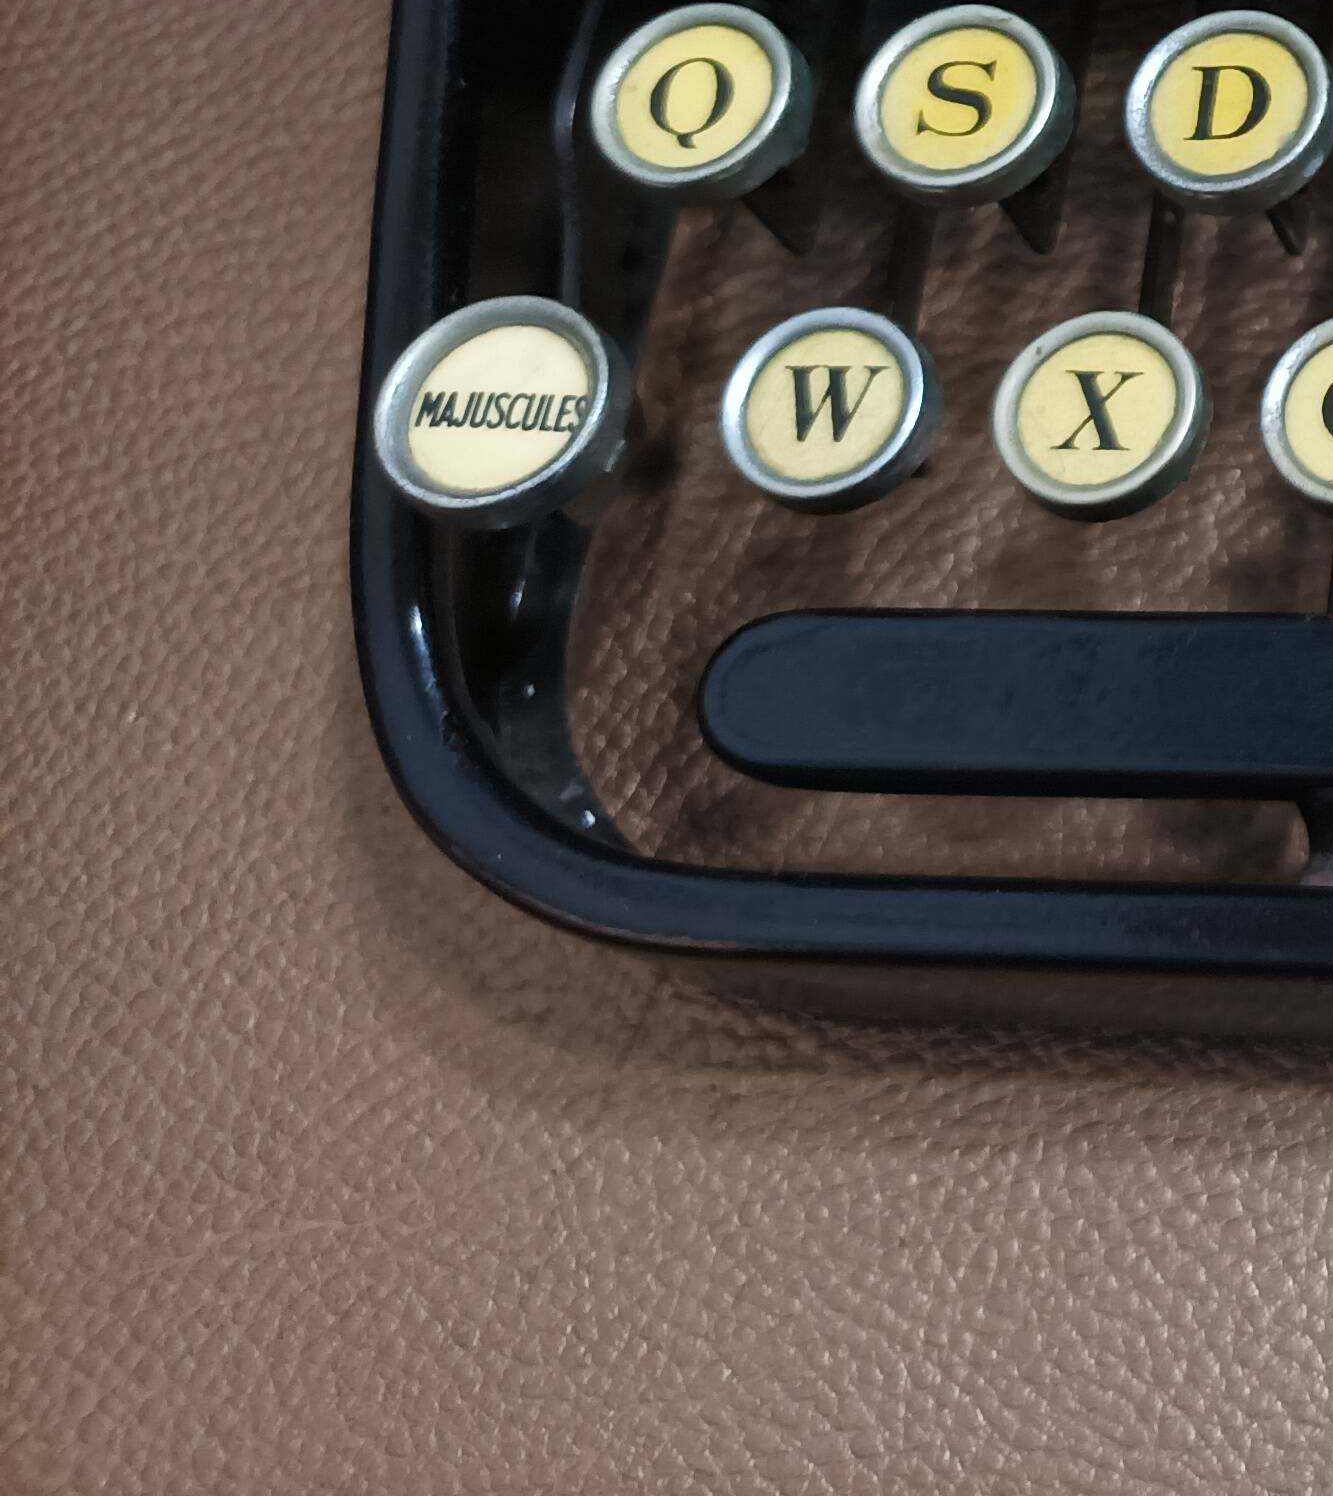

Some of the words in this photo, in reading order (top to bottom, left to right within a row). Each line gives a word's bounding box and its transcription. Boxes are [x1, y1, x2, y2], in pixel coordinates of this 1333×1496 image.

[649, 57, 735, 149] Q
[917, 61, 996, 136] S
[1184, 66, 1271, 140] D
[414, 390, 590, 432] MAJUSCULES
[784, 364, 892, 444] W
[1050, 370, 1143, 450] X
